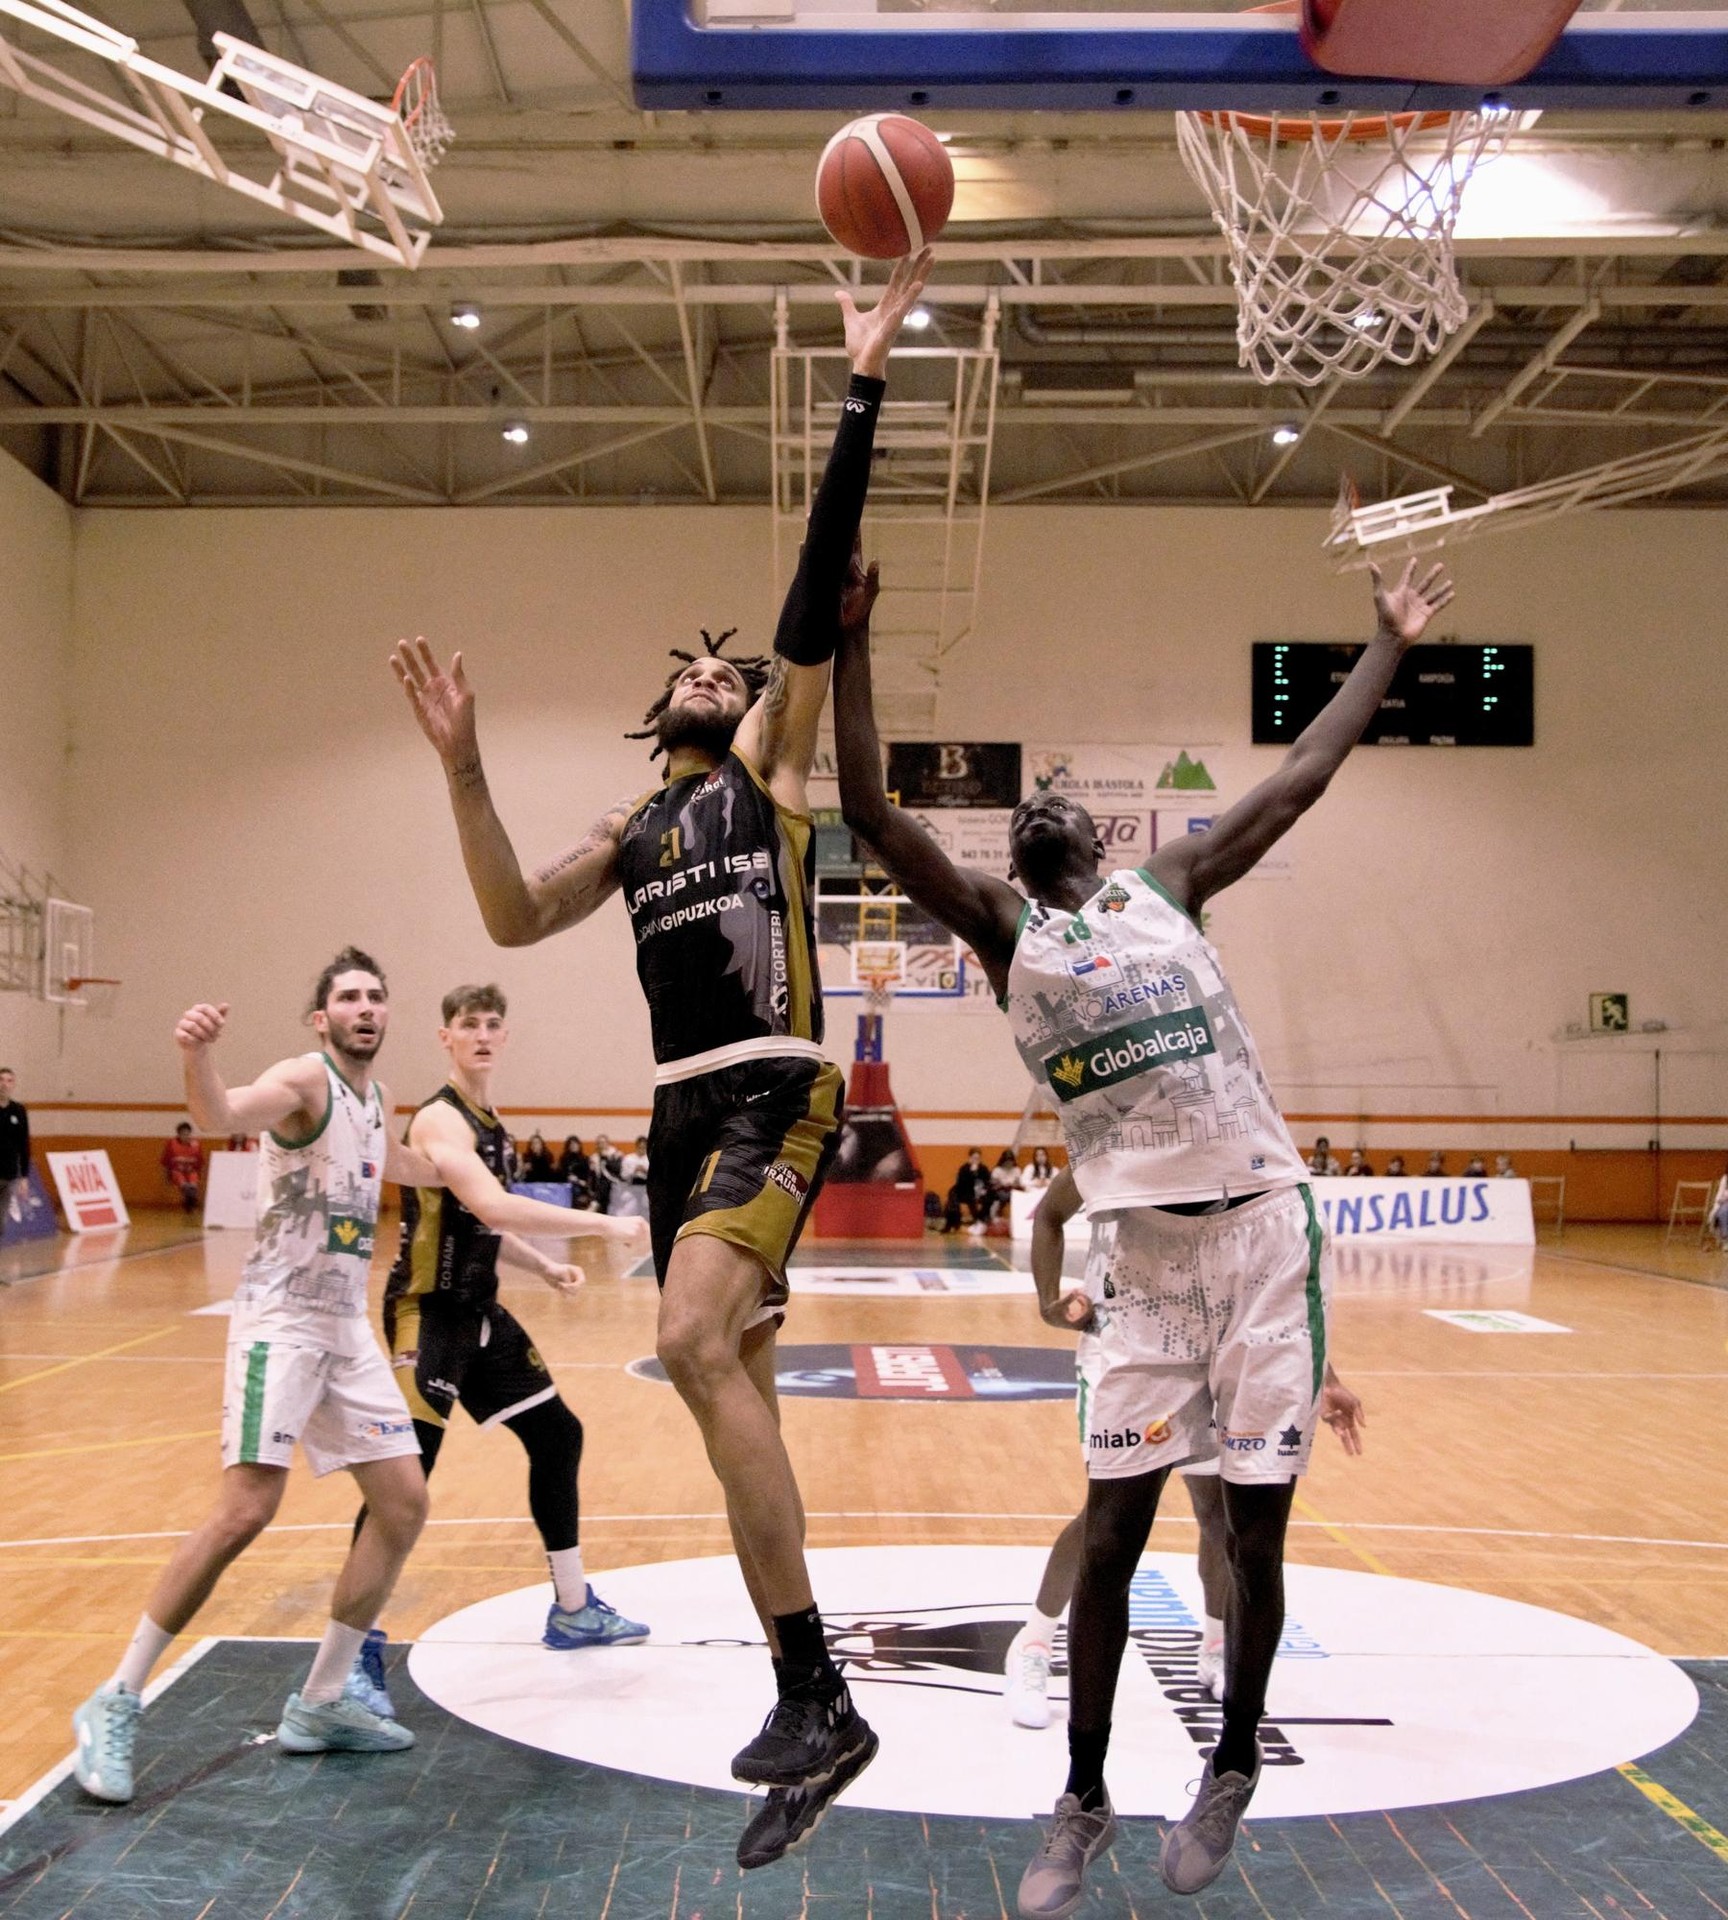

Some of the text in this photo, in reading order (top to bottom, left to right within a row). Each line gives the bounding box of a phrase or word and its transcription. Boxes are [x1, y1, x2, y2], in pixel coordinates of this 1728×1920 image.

[939, 745, 969, 779] B
[660, 893, 745, 931] GIPUZKOA
[770, 910, 787, 982] CORTEBI
[1104, 975, 1186, 1014] ARENAS
[1090, 1023, 1208, 1077] Globalcaja
[65, 1163, 107, 1194] AVIA
